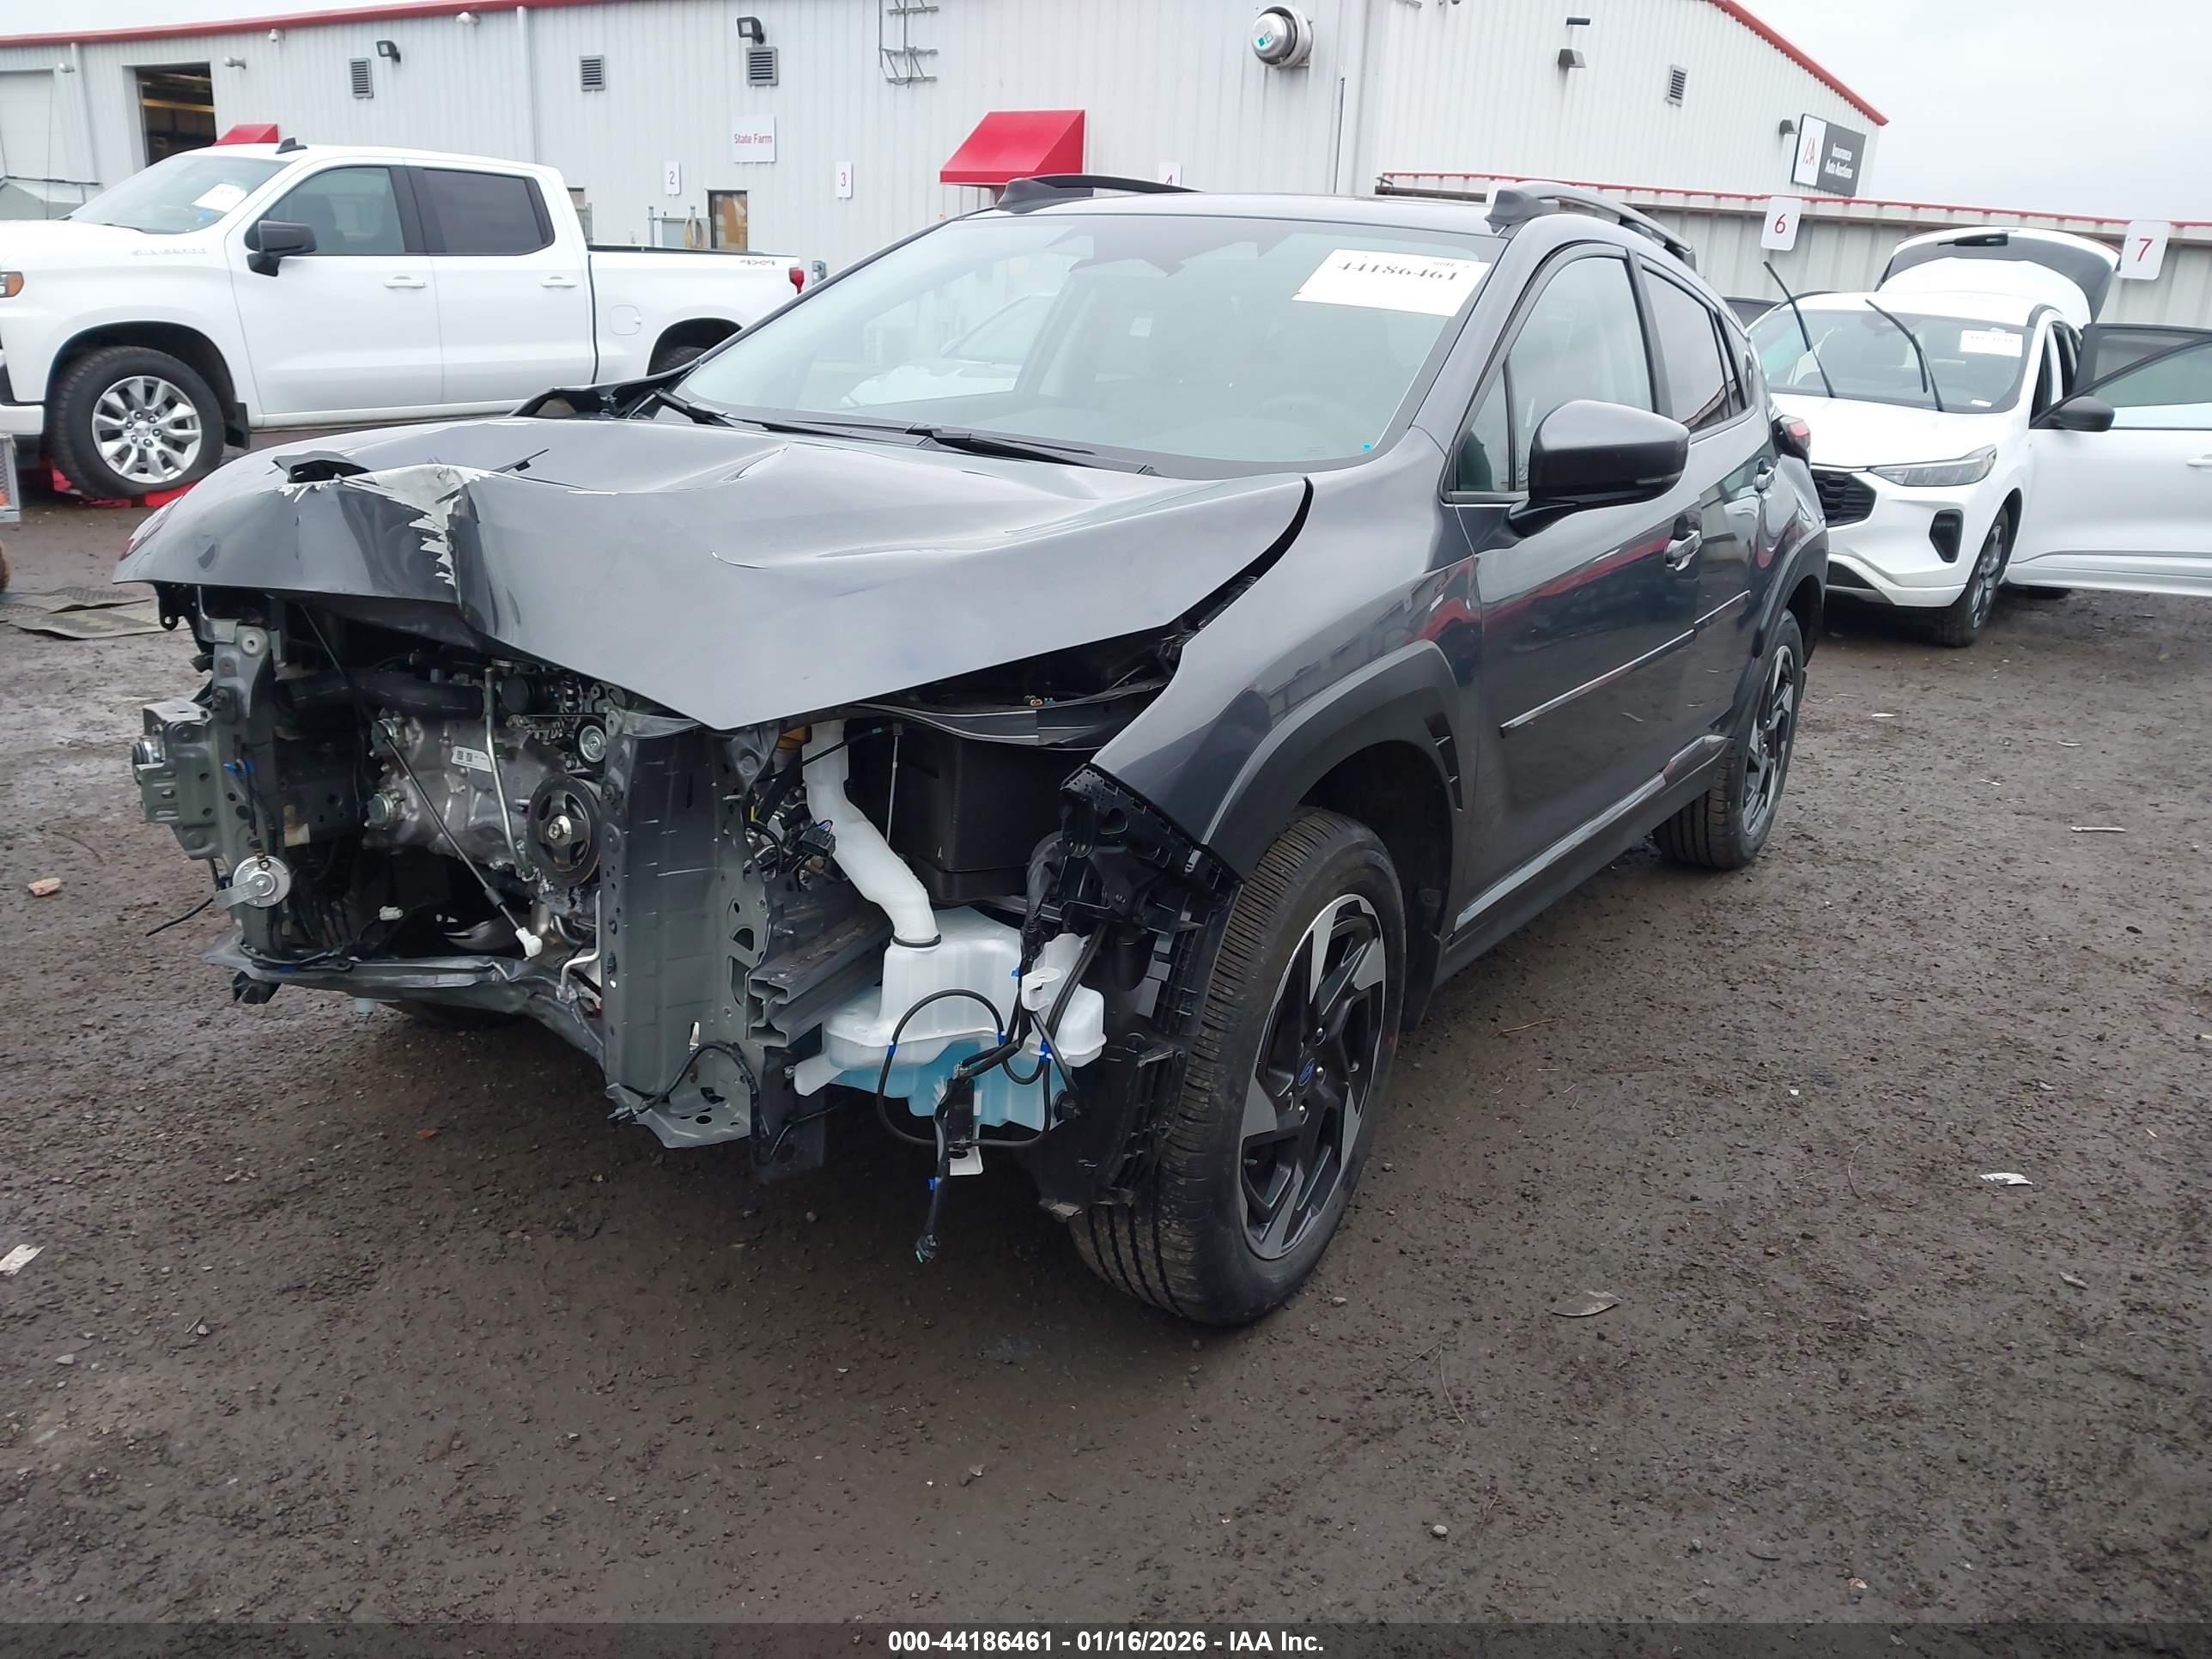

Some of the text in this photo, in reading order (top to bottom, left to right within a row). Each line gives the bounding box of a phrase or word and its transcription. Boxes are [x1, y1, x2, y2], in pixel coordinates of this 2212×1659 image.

[734, 133, 773, 144] State Farm
[669, 171, 675, 185] 2
[841, 172, 847, 187] 3
[1775, 213, 1786, 234] 6
[2137, 238, 2154, 262] 7
[1335, 261, 1459, 281] 44186461
